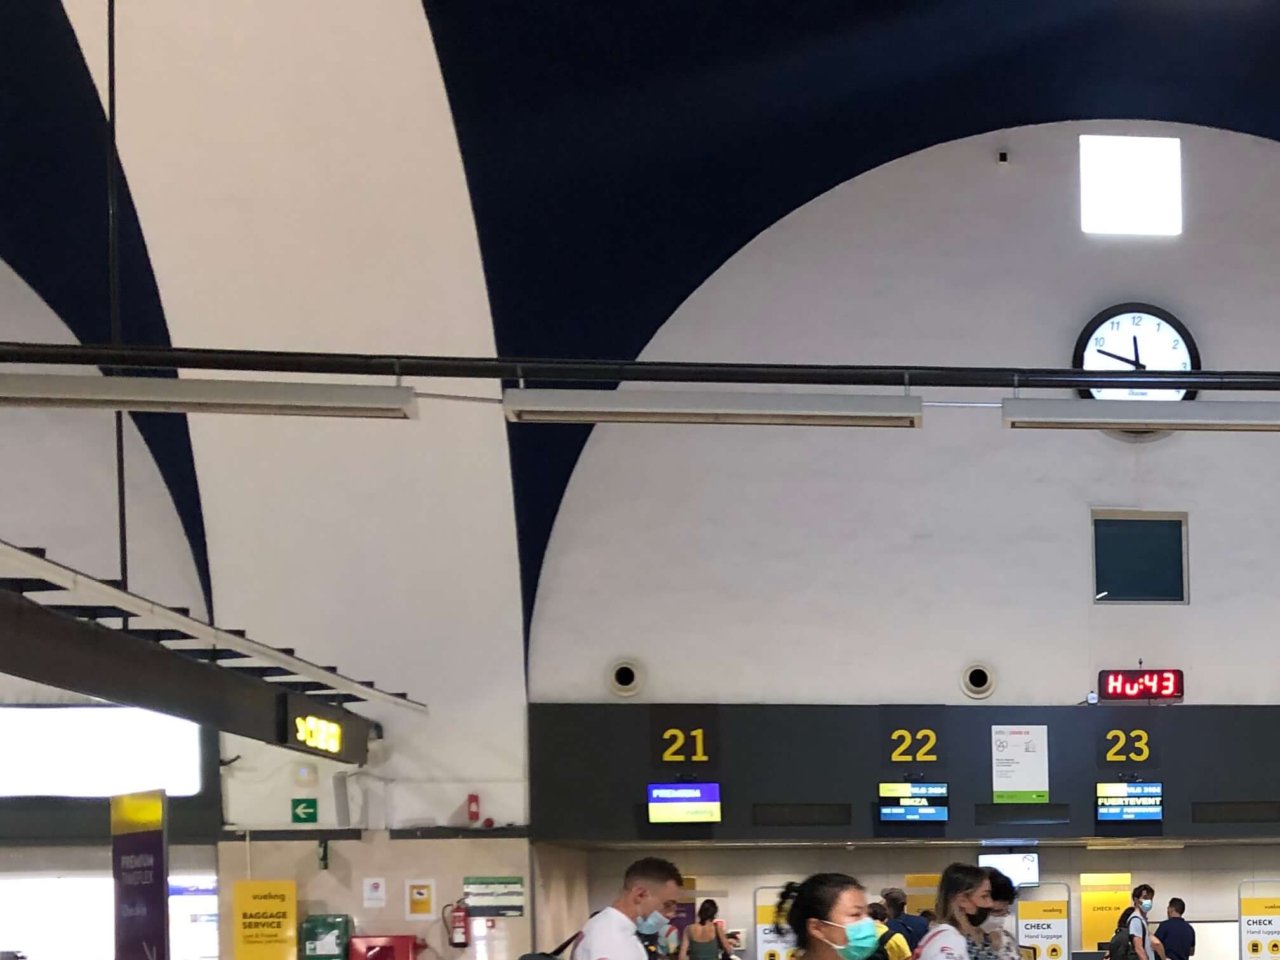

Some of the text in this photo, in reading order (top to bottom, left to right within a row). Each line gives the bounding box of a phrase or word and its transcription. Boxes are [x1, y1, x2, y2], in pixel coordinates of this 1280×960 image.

[1110, 320, 1121, 331] 11
[1131, 315, 1143, 327] 12
[1094, 336, 1105, 348] 10
[1172, 339, 1179, 350] 2
[662, 728, 709, 761] 21
[890, 728, 937, 761] 22
[1105, 729, 1150, 762] 23
[242, 911, 288, 919] BAGGAGE
[242, 921, 282, 929] SERVICE
